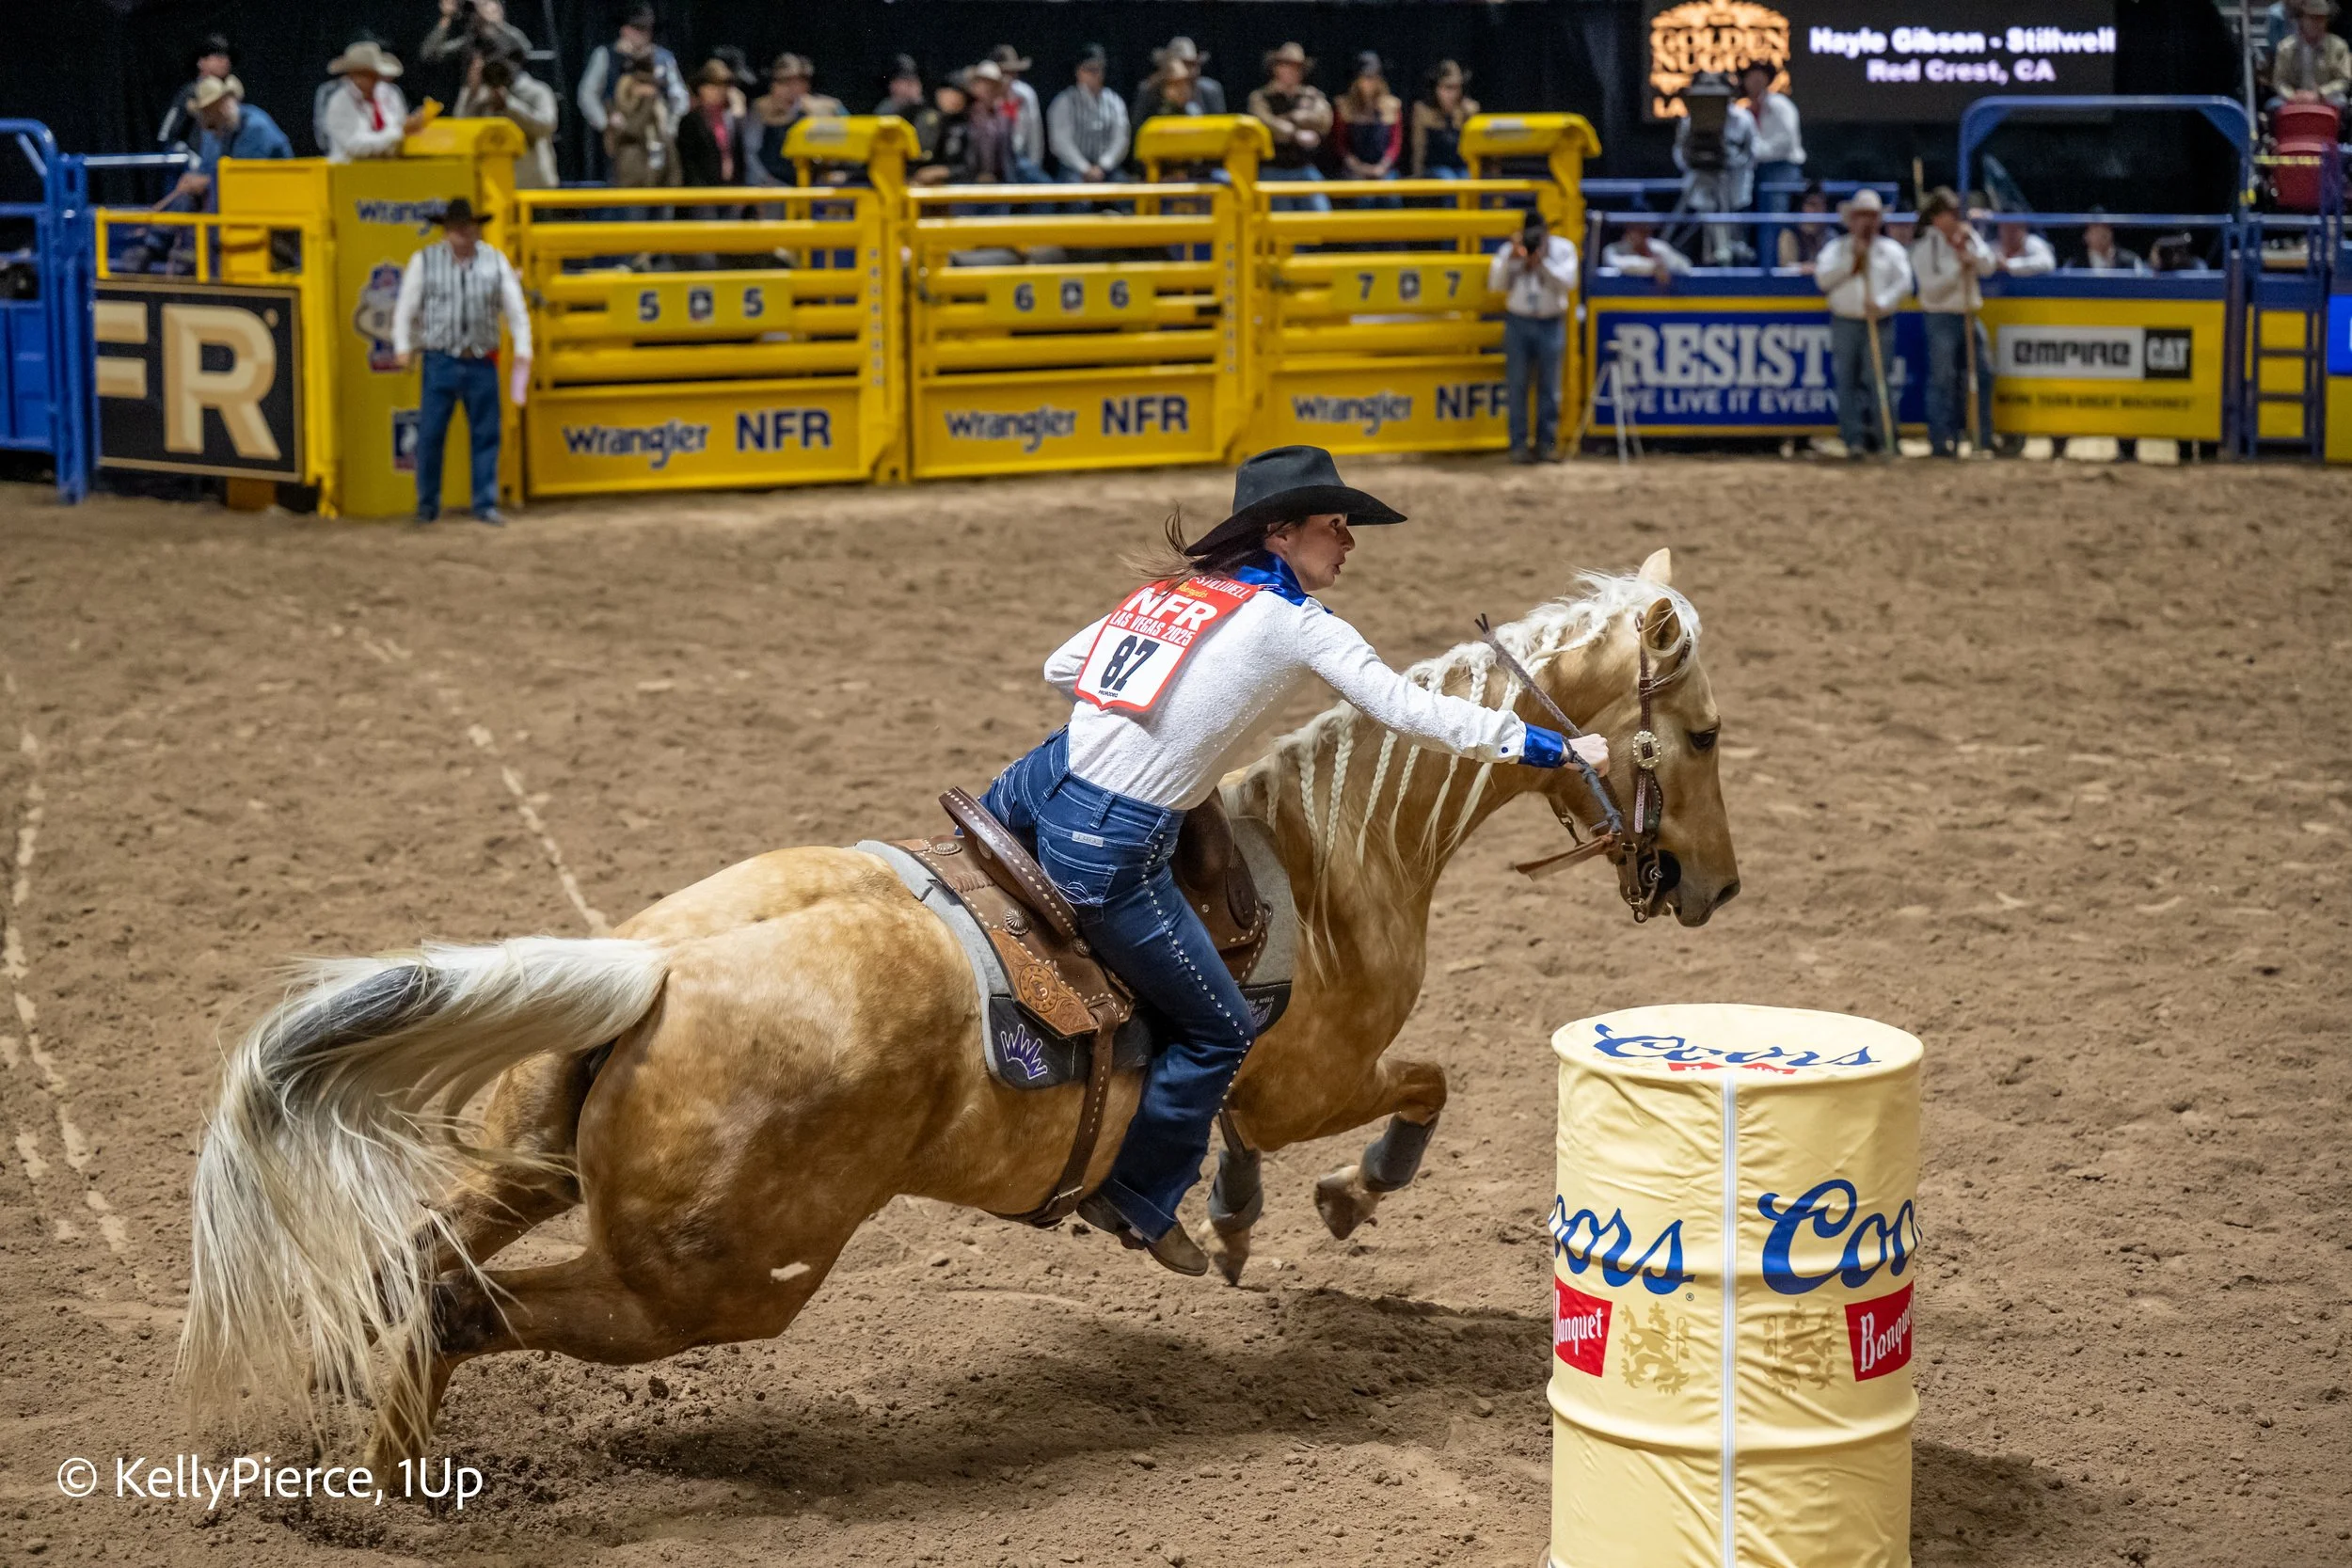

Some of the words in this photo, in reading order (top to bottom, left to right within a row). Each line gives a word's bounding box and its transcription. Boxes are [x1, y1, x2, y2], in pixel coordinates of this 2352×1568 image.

[1650, 27, 1790, 51] GOLDEN
[1891, 26, 1986, 54] Gibson
[2006, 26, 2116, 54] Stillwell
[1652, 49, 1790, 72] NUGGT
[1867, 58, 1921, 82] Red
[1925, 58, 2009, 85] Crest,
[2013, 58, 2057, 82] CA
[1014, 282, 1035, 311] 6
[1108, 279, 1130, 309] 6
[1358, 273, 1375, 301] 7
[1445, 271, 1462, 298] 7
[640, 290, 660, 322] 5
[743, 287, 765, 318] 5
[2146, 337, 2190, 372] CAT
[94, 300, 281, 461] FR
[1292, 390, 1413, 436] Wrangler
[1663, 389, 1722, 414] LIVE
[1728, 389, 1753, 414] IT
[564, 420, 710, 470] Wrangler
[735, 408, 832, 451] NFR
[944, 404, 1078, 453] Wrangler
[1101, 395, 1189, 435] NFR
[1123, 587, 1218, 631] NFR
[1108, 610, 1133, 626] LAS
[1131, 614, 1165, 636] VEGAS
[1161, 624, 1196, 647] 2025
[1100, 635, 1161, 691] 87
[1594, 1023, 1882, 1067] Coors
